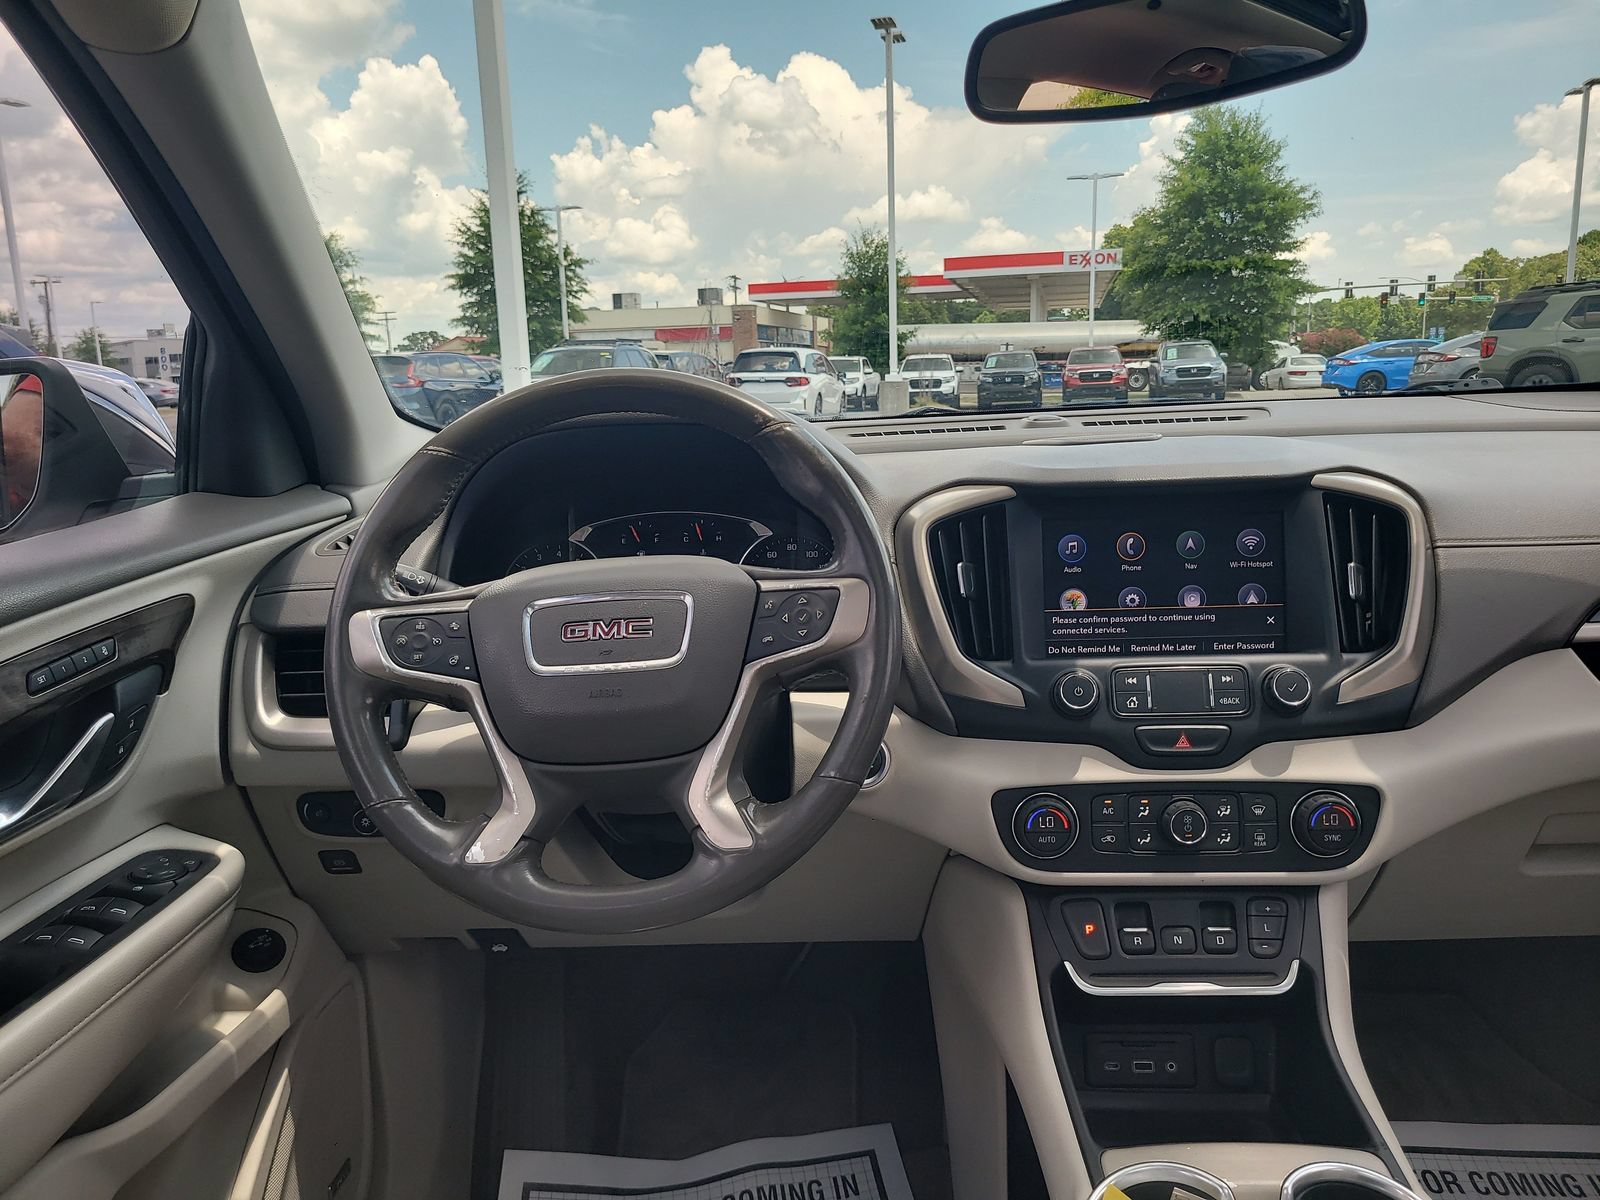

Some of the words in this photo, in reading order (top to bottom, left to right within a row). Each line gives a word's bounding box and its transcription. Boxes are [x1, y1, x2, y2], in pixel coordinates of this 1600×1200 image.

[1068, 252, 1118, 268] EXXON
[786, 543, 797, 551] 80
[766, 551, 778, 559] 60
[805, 550, 819, 558] 100
[1063, 565, 1082, 573] Audio
[1121, 564, 1142, 572] Phone
[1185, 562, 1198, 570] Nav
[1229, 560, 1247, 568] Wi-Fi
[1247, 560, 1274, 569] Hotspot
[1052, 616, 1077, 624] Please
[1078, 615, 1109, 624] confirm
[1110, 614, 1147, 624] password
[1149, 614, 1157, 622] to
[1158, 613, 1193, 622] continue
[1194, 613, 1216, 622] using
[561, 618, 653, 642] GMC
[1052, 626, 1093, 635] connected
[1094, 626, 1128, 634] services.
[1048, 645, 1060, 654] Do
[1061, 645, 1076, 654] Not
[1077, 645, 1106, 653] Remind
[1107, 644, 1121, 653] Me
[1130, 643, 1160, 652] Remind
[1161, 643, 1175, 652] Me
[1176, 643, 1197, 651] Later
[1213, 641, 1235, 650] Enter
[1236, 640, 1275, 650] Password
[37, 674, 47, 685] SET
[1223, 697, 1241, 705] BACK
[1102, 807, 1115, 815] A/C
[1038, 835, 1056, 844] AUTO
[1323, 834, 1342, 842] SYNC
[1084, 924, 1094, 935] P
[1263, 923, 1271, 932] L
[1134, 936, 1143, 946] R
[1173, 935, 1183, 945] N
[1216, 936, 1225, 945] D
[721, 1179, 825, 1200] MING
[832, 1173, 860, 1200] IN
[1413, 1169, 1466, 1195] OR
[1467, 1170, 1587, 1198] COMING
[1586, 1174, 1600, 1197] I
